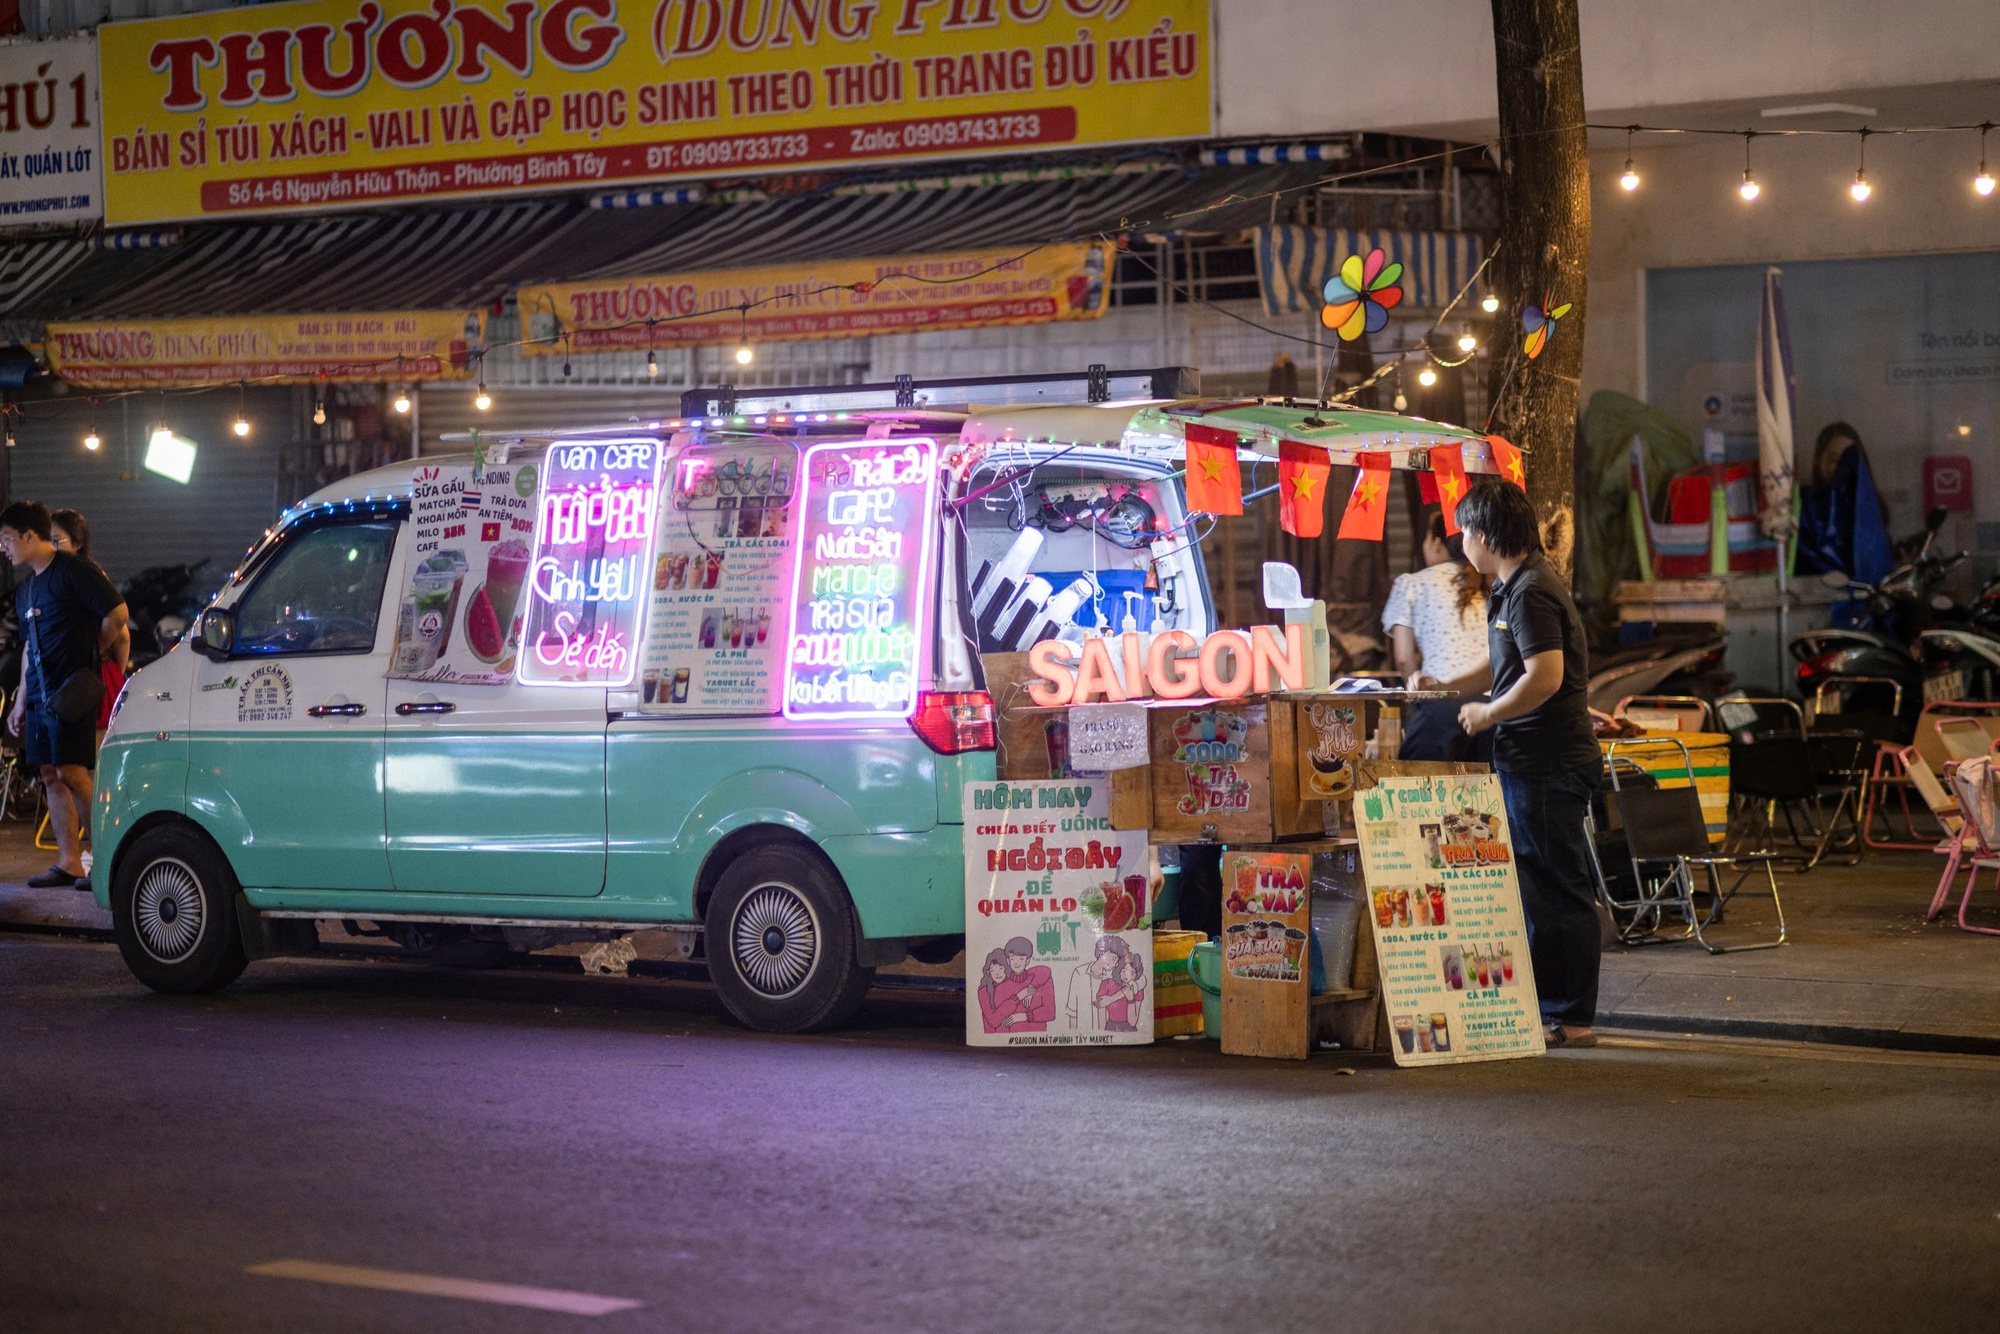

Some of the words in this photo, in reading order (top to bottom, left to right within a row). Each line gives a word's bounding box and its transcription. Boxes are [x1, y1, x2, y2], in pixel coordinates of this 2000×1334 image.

[150, 0, 625, 111] THƯƠNG
[70, 73, 91, 128] 1
[112, 125, 171, 173] BÁN
[179, 117, 207, 167] SỈ
[215, 117, 260, 163] TÚI
[269, 113, 347, 160] XÁCH
[440, 94, 480, 145] VÀ
[489, 89, 551, 146] CẶP
[562, 87, 627, 139] HỌC
[638, 79, 717, 126] SINH
[727, 69, 812, 118] THEO
[823, 52, 902, 109] THỜI
[913, 49, 1033, 99] TRANG
[1045, 28, 1096, 88] ĐỦ
[1108, 18, 1197, 83] KIỂU
[67, 145, 92, 173] LÓT
[228, 176, 250, 206] Số
[254, 181, 284, 202] 4-6
[286, 171, 351, 203] Nguyễn
[355, 166, 392, 200] Hữu
[395, 168, 441, 193] Thận
[454, 160, 525, 186] Phường
[572, 150, 608, 178] Tây
[681, 133, 810, 167] 0909.733.733
[904, 114, 1041, 147] 0909.743.733
[570, 282, 696, 324] THƯƠNG
[54, 326, 155, 361] THƯƠNG
[414, 483, 439, 499] SỮA
[441, 476, 466, 493] GẤU
[419, 498, 456, 511] MATCHA
[491, 495, 507, 506] TRÀ
[508, 498, 527, 510] DƯA
[417, 513, 445, 526] KHOAI
[447, 508, 467, 520] MÔN
[478, 508, 491, 519] AN
[493, 510, 513, 522] TIÊM
[417, 527, 439, 539] MILO
[417, 541, 438, 553] CAFE
[724, 539, 742, 549] TRÀ
[745, 540, 764, 549] CÁC
[767, 540, 790, 549] LOẠI
[678, 595, 702, 604] NƯỚC
[715, 650, 727, 659] CÀ
[730, 649, 748, 659] PHÊ
[1028, 624, 1305, 706] SAIGON
[706, 679, 738, 687] YAOURT
[741, 677, 756, 687] LẮC
[1185, 742, 1239, 763] SODA
[1209, 765, 1238, 786] Trà
[974, 783, 1032, 810] HÔM
[1038, 786, 1093, 808] NAY
[976, 822, 1019, 835] CHƯA
[1022, 820, 1057, 834] BIẾT
[1060, 810, 1112, 833] UỐNG
[987, 837, 1063, 872] NGỒI
[1064, 840, 1122, 870] ĐÂY
[1440, 838, 1475, 863] TRÀ
[1025, 870, 1054, 896] ĐỂ
[1258, 864, 1304, 890] TRÀ
[1440, 868, 1459, 880] TRÀ
[1463, 867, 1481, 879] CÁC
[1484, 868, 1508, 879] LOẠI
[977, 890, 1044, 917] QUÁN
[1049, 897, 1078, 913] LO
[1410, 931, 1435, 942] NƯỚC
[1437, 930, 1448, 940] ÉP
[1466, 988, 1479, 1000] CÀ
[1482, 986, 1500, 998] PHÊ
[1466, 1021, 1498, 1031] YAOURT
[1500, 1017, 1516, 1028] LẮC
[1008, 1036, 1038, 1046] #SAIGON
[1075, 1034, 1088, 1044] TÂY
[1089, 1035, 1113, 1044] MARKET
